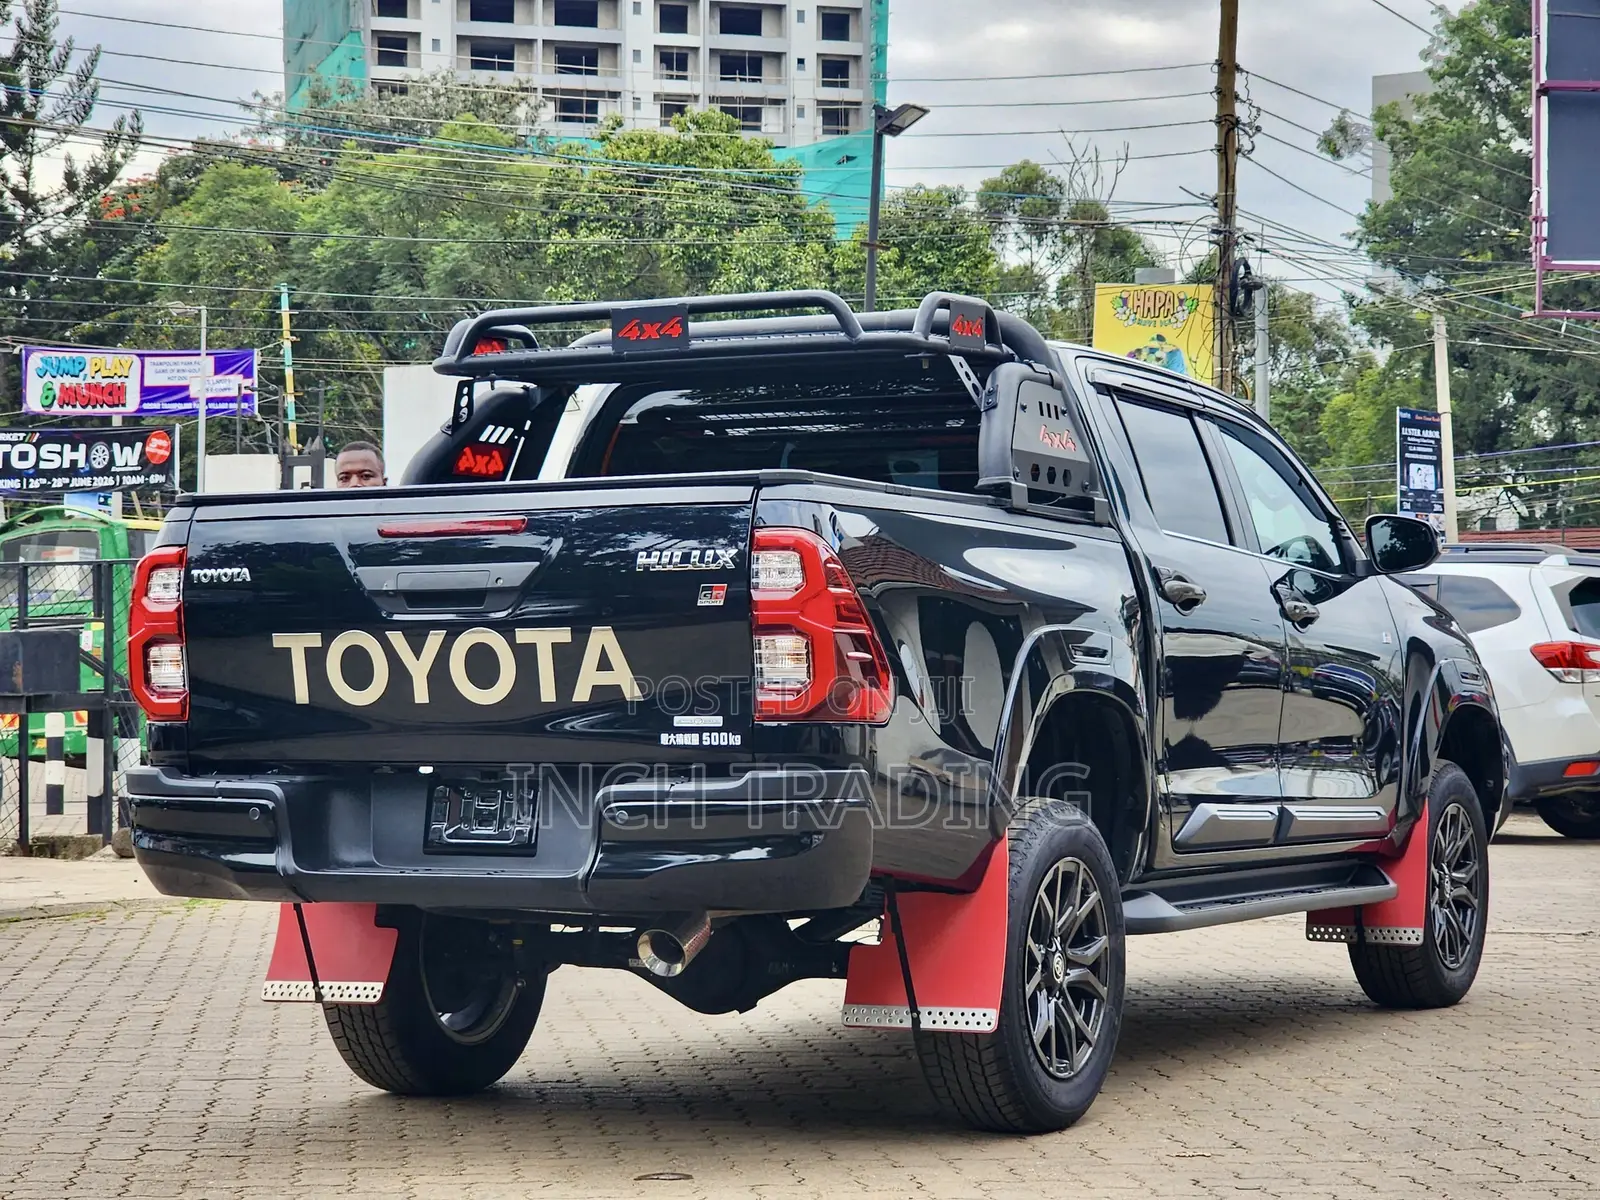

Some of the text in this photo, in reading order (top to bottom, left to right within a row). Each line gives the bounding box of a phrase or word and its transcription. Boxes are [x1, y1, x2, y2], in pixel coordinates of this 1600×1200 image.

[1133, 289, 1175, 319] HAPA
[618, 317, 683, 340] 4x4
[952, 313, 983, 337] 4x4
[35, 355, 133, 380] JUMP, PLAY
[40, 381, 127, 409] & MUNCH
[1039, 424, 1076, 451] 4x4
[69, 476, 92, 488] JUNE
[93, 475, 115, 486] 2026
[635, 549, 739, 572] HILUX
[190, 567, 252, 584] TOYOTA
[700, 590, 724, 600] GR
[272, 625, 645, 706] TOYOTA
[702, 732, 742, 747] 500kg
